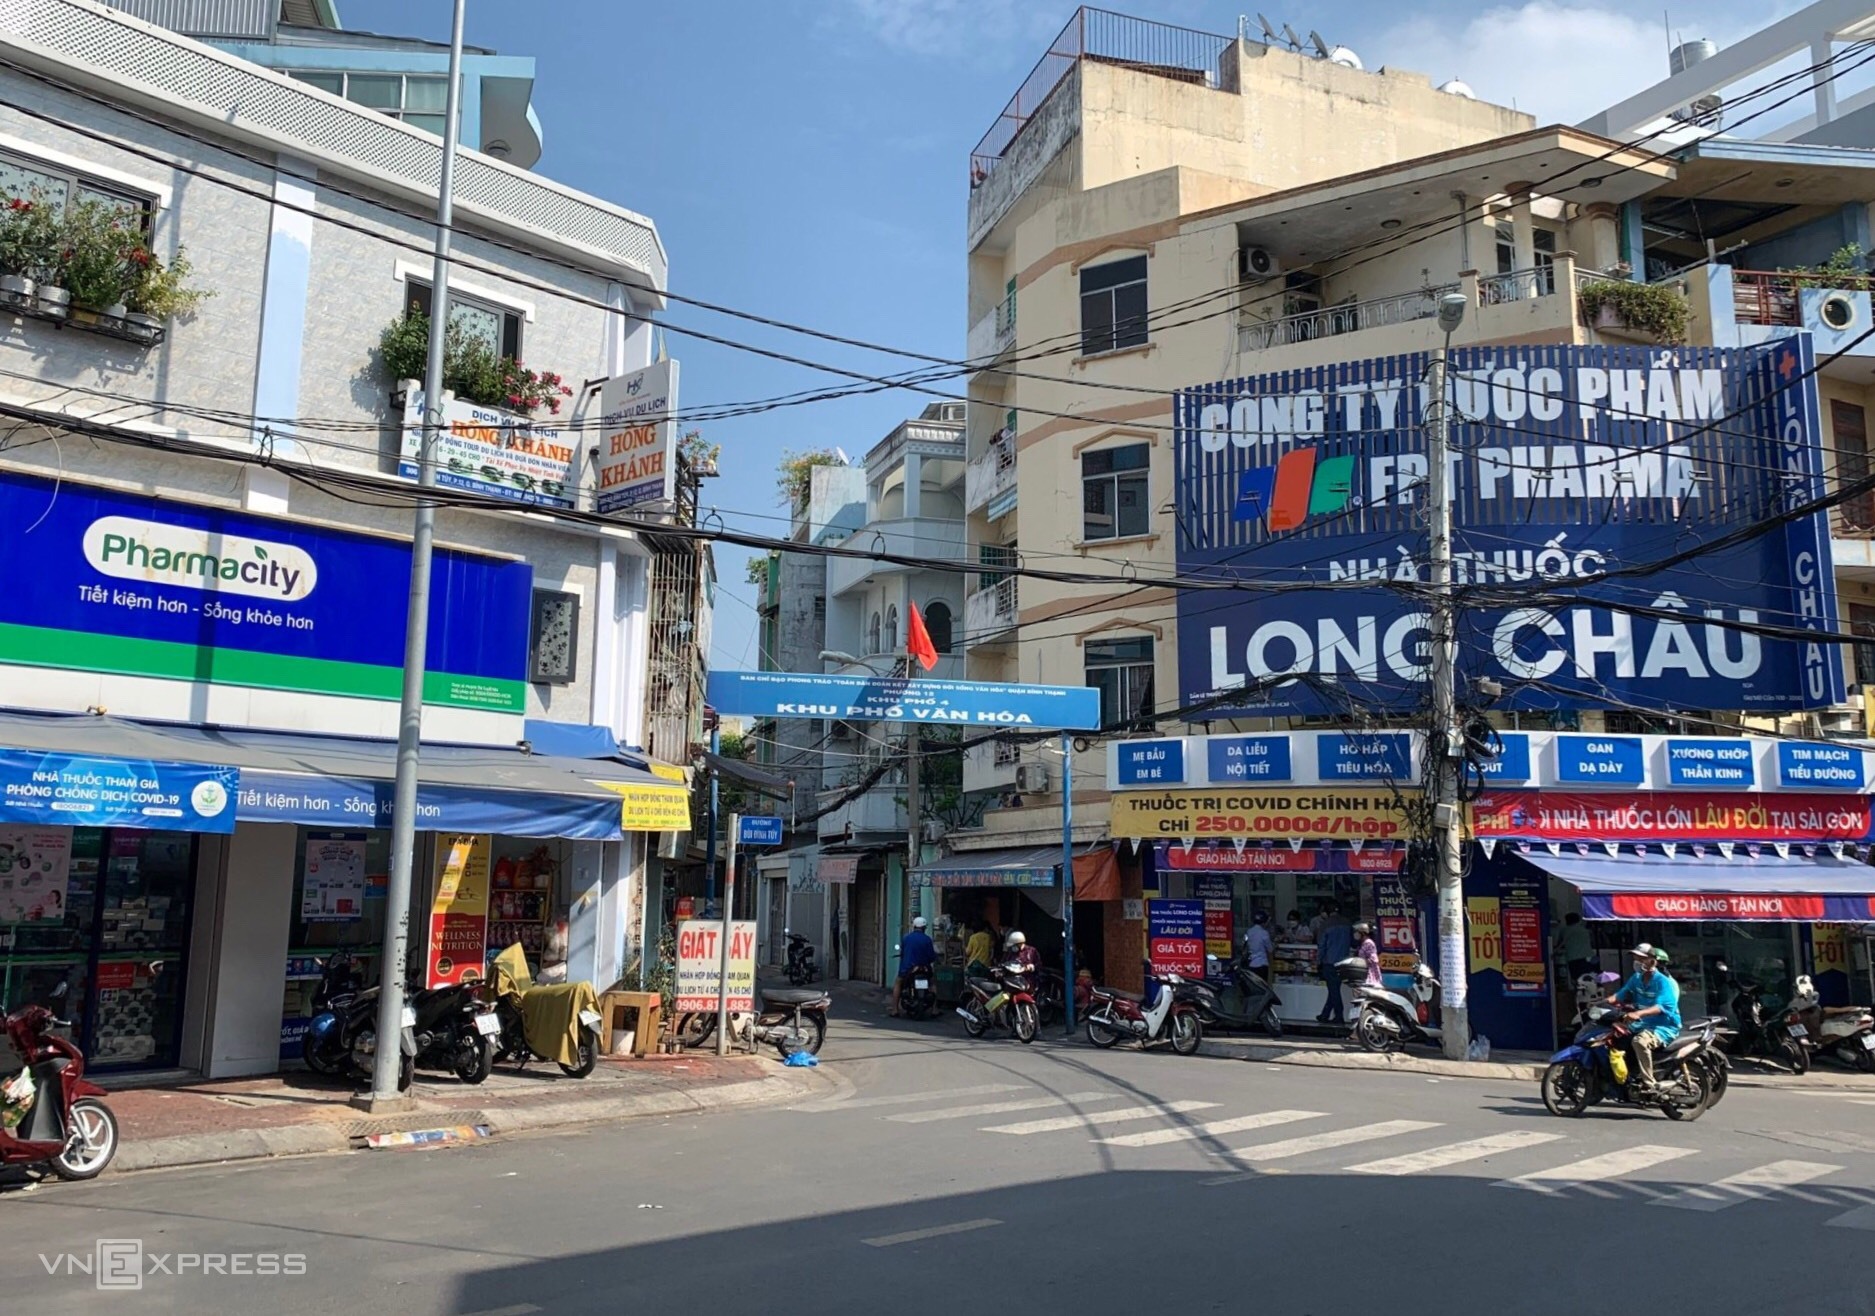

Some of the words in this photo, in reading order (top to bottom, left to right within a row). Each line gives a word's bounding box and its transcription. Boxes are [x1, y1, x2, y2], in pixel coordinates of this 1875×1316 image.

[636, 404, 647, 415] DU
[648, 397, 667, 411] LỊCH
[1200, 389, 1324, 453] CÔNG
[1339, 379, 1403, 431] TY
[1577, 350, 1725, 420] PHẨM
[472, 410, 498, 424] DỊCH
[451, 419, 501, 447] HỒNG
[506, 433, 574, 464] KHÁNH
[610, 420, 657, 456] HỒNG
[464, 441, 479, 451] TOUR
[481, 446, 490, 454] DU
[600, 452, 664, 489] KHÁNH
[1478, 446, 1700, 499] PHARMA
[102, 533, 300, 595] Pharmacity
[1329, 545, 1419, 583] NHÀ
[1452, 531, 1606, 585] THUỐC
[78, 585, 108, 603] Tiết
[113, 589, 152, 611] kiệm
[157, 596, 188, 614] hơn
[203, 602, 242, 624] Sống
[246, 608, 282, 626] khỏe
[286, 613, 314, 630] hơn
[1210, 612, 1459, 690] LONG
[1492, 591, 1762, 680] CHÂU
[904, 697, 937, 705] PHỐ
[777, 703, 838, 716] KHU
[847, 704, 904, 719] PHỐ
[913, 707, 969, 721] VĂN
[978, 709, 1033, 724] HÓA
[1132, 751, 1145, 763] MẸ
[1147, 747, 1166, 760] BẦU
[1227, 746, 1243, 757] DA
[1245, 742, 1268, 756] LIỄU
[1362, 741, 1389, 755] HẤP
[1587, 743, 1614, 754] GAN
[1672, 748, 1714, 760] XƯƠNG
[1717, 748, 1749, 760] KHỚP
[1792, 749, 1812, 760] TIM
[1815, 750, 1850, 763] MẠCH
[1136, 769, 1149, 779] EM
[1150, 767, 1162, 778] BÉ
[1226, 762, 1247, 777] NỘI
[1249, 762, 1271, 775] TIẾT
[1336, 761, 1361, 775] TIÊU
[1579, 763, 1597, 776] DẠ
[1599, 760, 1623, 773] DÀY
[1681, 764, 1712, 778] THẦN
[1715, 768, 1743, 778] KINH
[1788, 764, 1811, 779] TIỂU
[1814, 766, 1857, 780] ĐƯỜNG
[33, 771, 59, 783] NHÀ
[63, 771, 101, 786] THUỐC
[105, 777, 137, 788] THAM
[140, 779, 159, 789] GIA
[7, 783, 51, 797] PHÒNG
[55, 784, 98, 800] CHỐNG
[101, 789, 128, 803] DỊCH
[131, 793, 180, 805] COVID-19
[237, 789, 261, 806] Tiết
[265, 793, 300, 811] kiệm
[304, 795, 330, 811] hơn
[344, 796, 377, 817] Sống
[416, 801, 441, 817] hơn
[1129, 793, 1188, 811] THUỐC
[1191, 797, 1222, 814] TRỊ
[1225, 797, 1292, 811] COVID
[1296, 795, 1368, 811] CHÍNH
[1553, 804, 1591, 830] NHÀ
[1594, 801, 1654, 830] THUỐC
[1656, 805, 1692, 830] LỚN
[1695, 803, 1729, 830] LÂU
[1733, 802, 1768, 830] ĐỜI
[1771, 811, 1795, 835] TẠI
[1799, 808, 1823, 830] SÀI
[1826, 808, 1863, 830] GÒN
[1159, 816, 1189, 832] CHỈ
[1196, 816, 1398, 838] 250.000đ/hộp
[1196, 853, 1219, 865] GIAO
[1220, 851, 1246, 865] HÀNG
[1268, 852, 1285, 865] NƠI
[1655, 899, 1688, 912] GIAO
[1691, 895, 1728, 912] HÀNG
[1730, 897, 1757, 916] TẬN
[1759, 898, 1783, 912] NƠI
[435, 930, 481, 941] WELLNESS
[1160, 926, 1176, 935] LÂU
[431, 940, 483, 951] NUTRITION
[680, 927, 717, 966] GIẶT
[730, 924, 753, 960] ẤY
[1157, 942, 1175, 953] GIÁ
[1177, 941, 1198, 955] TỐT
[1153, 961, 1182, 973] THUỐC
[737, 971, 750, 981] QUAN
[734, 986, 741, 994] 45
[676, 1000, 752, 1011] 0906.81.882
